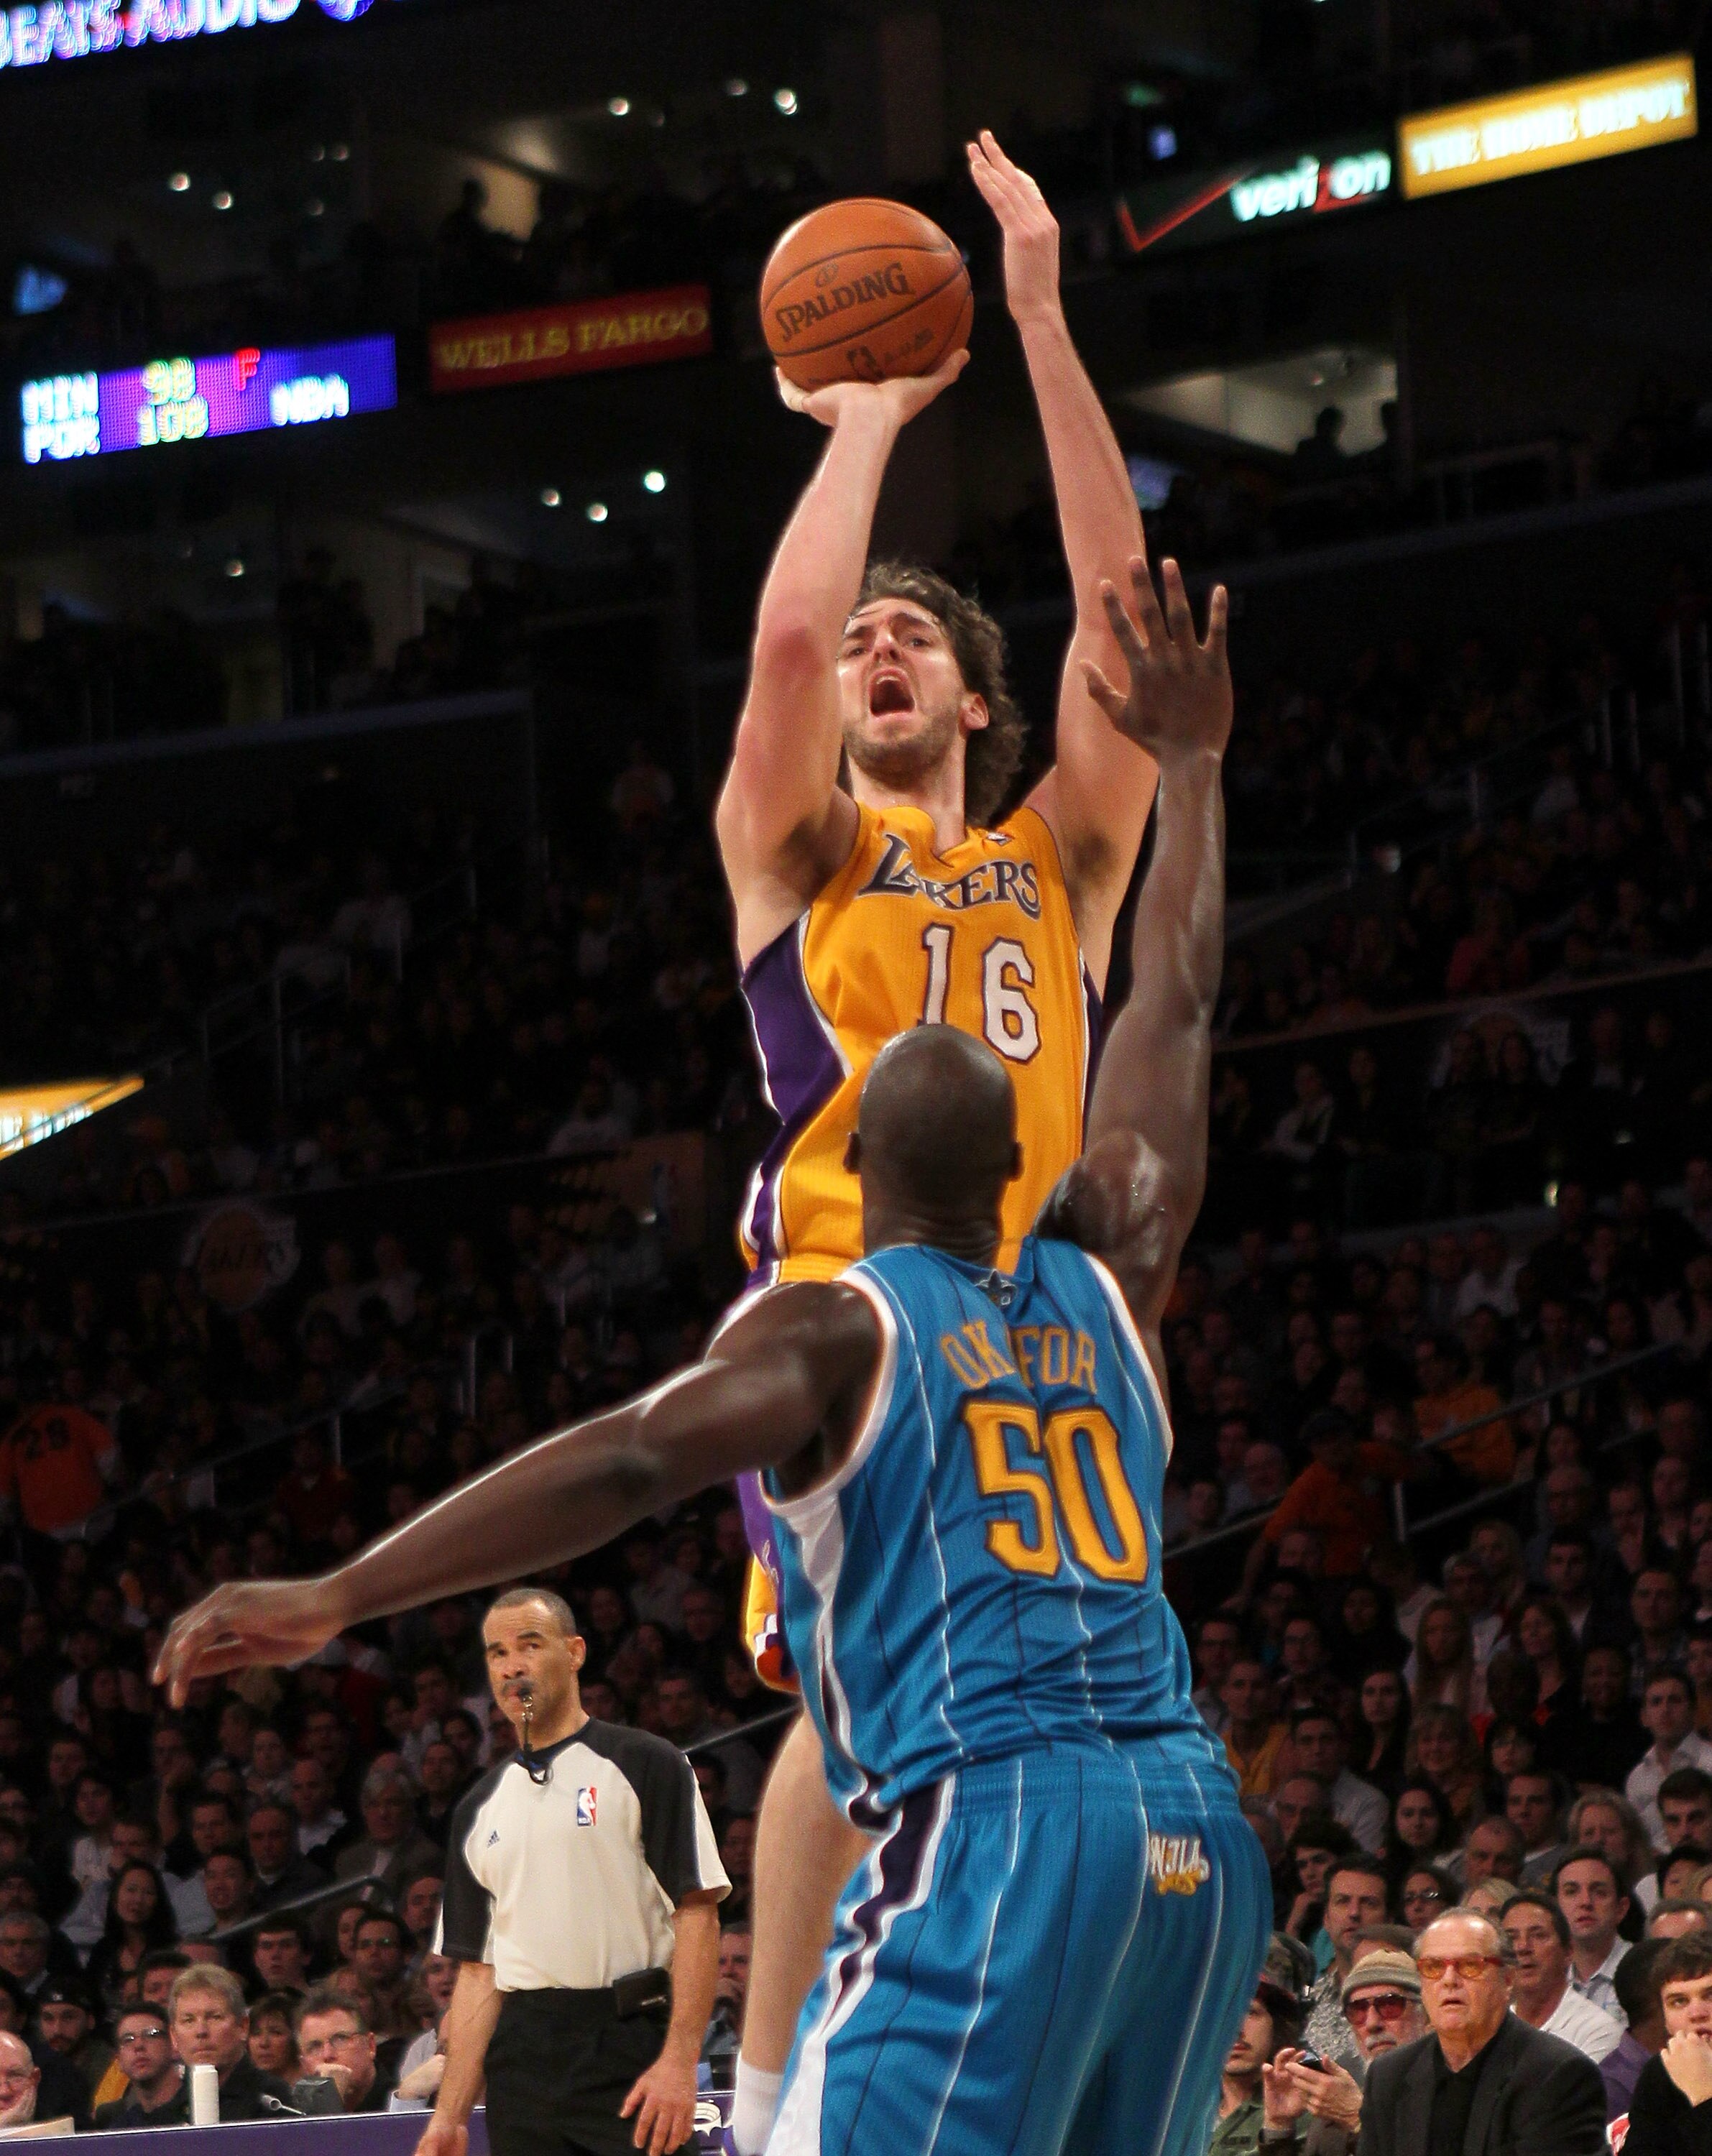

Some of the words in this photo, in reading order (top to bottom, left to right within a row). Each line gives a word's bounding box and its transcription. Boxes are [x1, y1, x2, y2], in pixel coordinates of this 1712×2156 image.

[439, 326, 571, 372] WELLS
[579, 307, 709, 352] FARGO
[775, 261, 913, 343] SPALDING
[236, 347, 261, 392] F
[857, 833, 1041, 921] LAKERS
[917, 921, 1041, 1065] 16
[940, 1319, 1098, 1396] OKFOR
[962, 1399, 1150, 1584] 50
